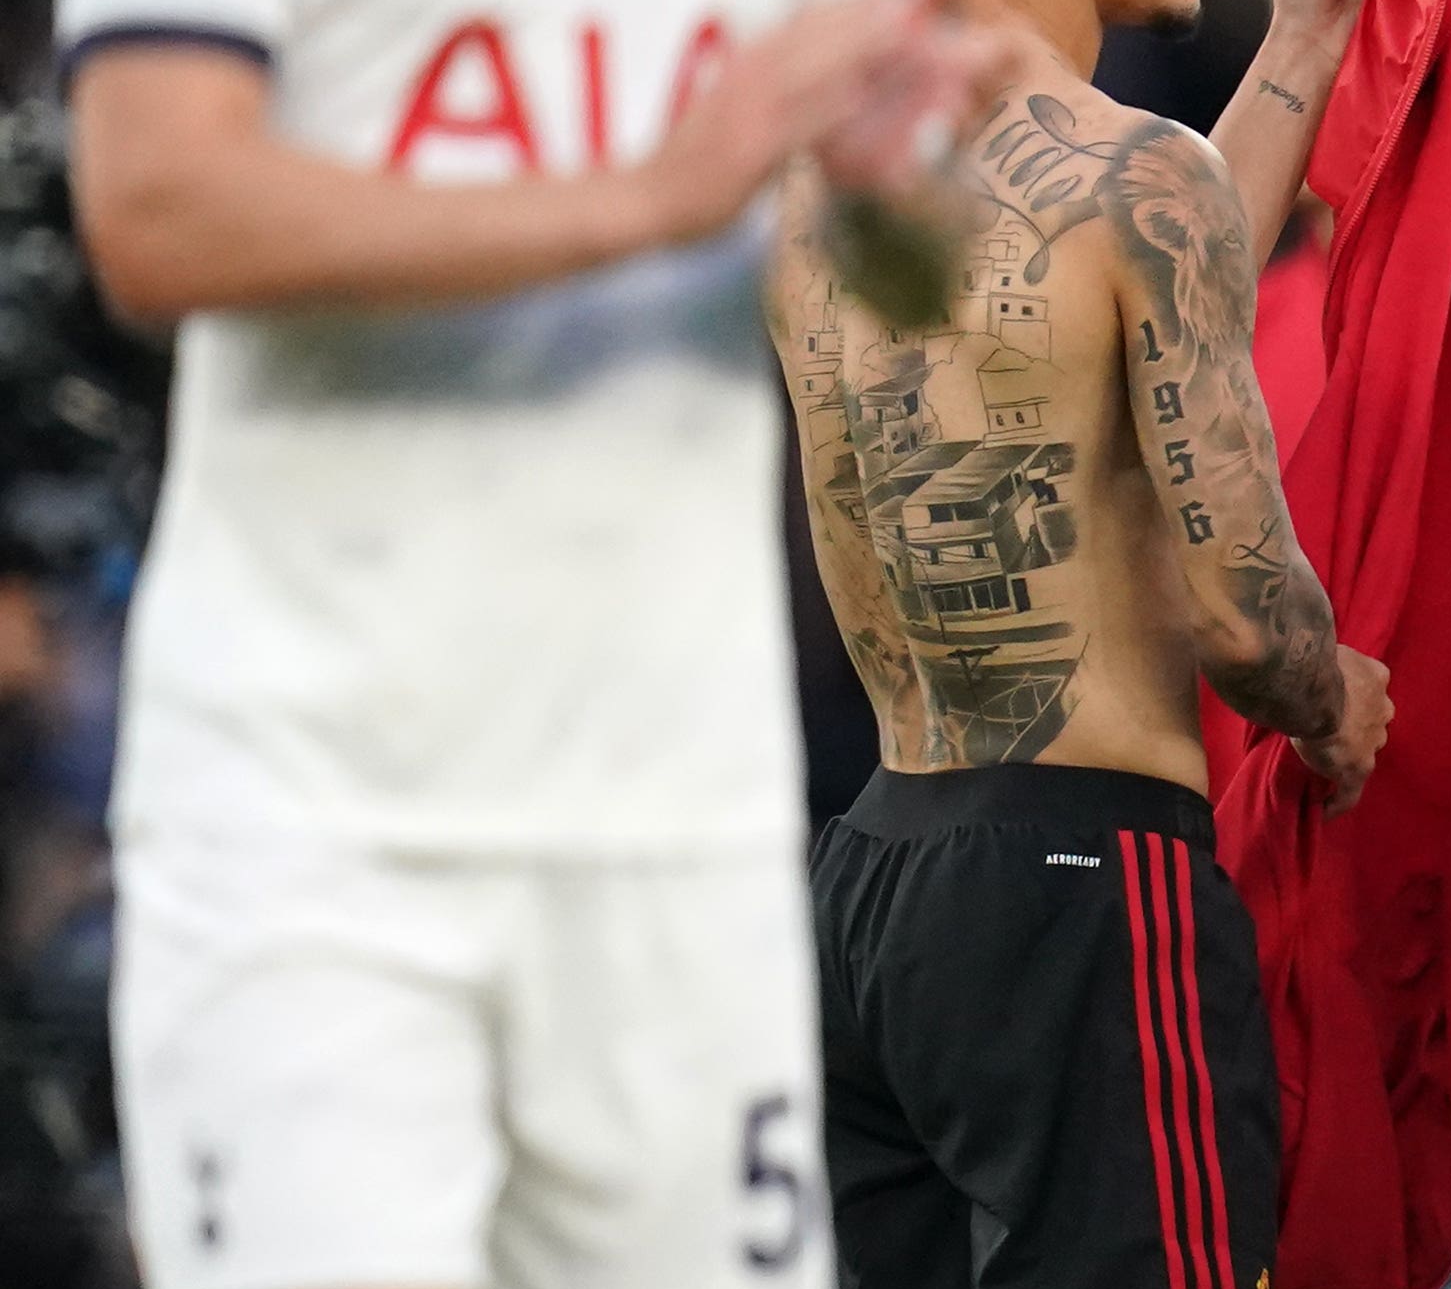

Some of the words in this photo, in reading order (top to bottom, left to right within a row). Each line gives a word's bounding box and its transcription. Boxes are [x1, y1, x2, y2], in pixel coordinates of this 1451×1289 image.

[1139, 320, 1215, 544] 1956
[1046, 854, 1101, 867] AEROREADY
[743, 1094, 814, 1275] 5
